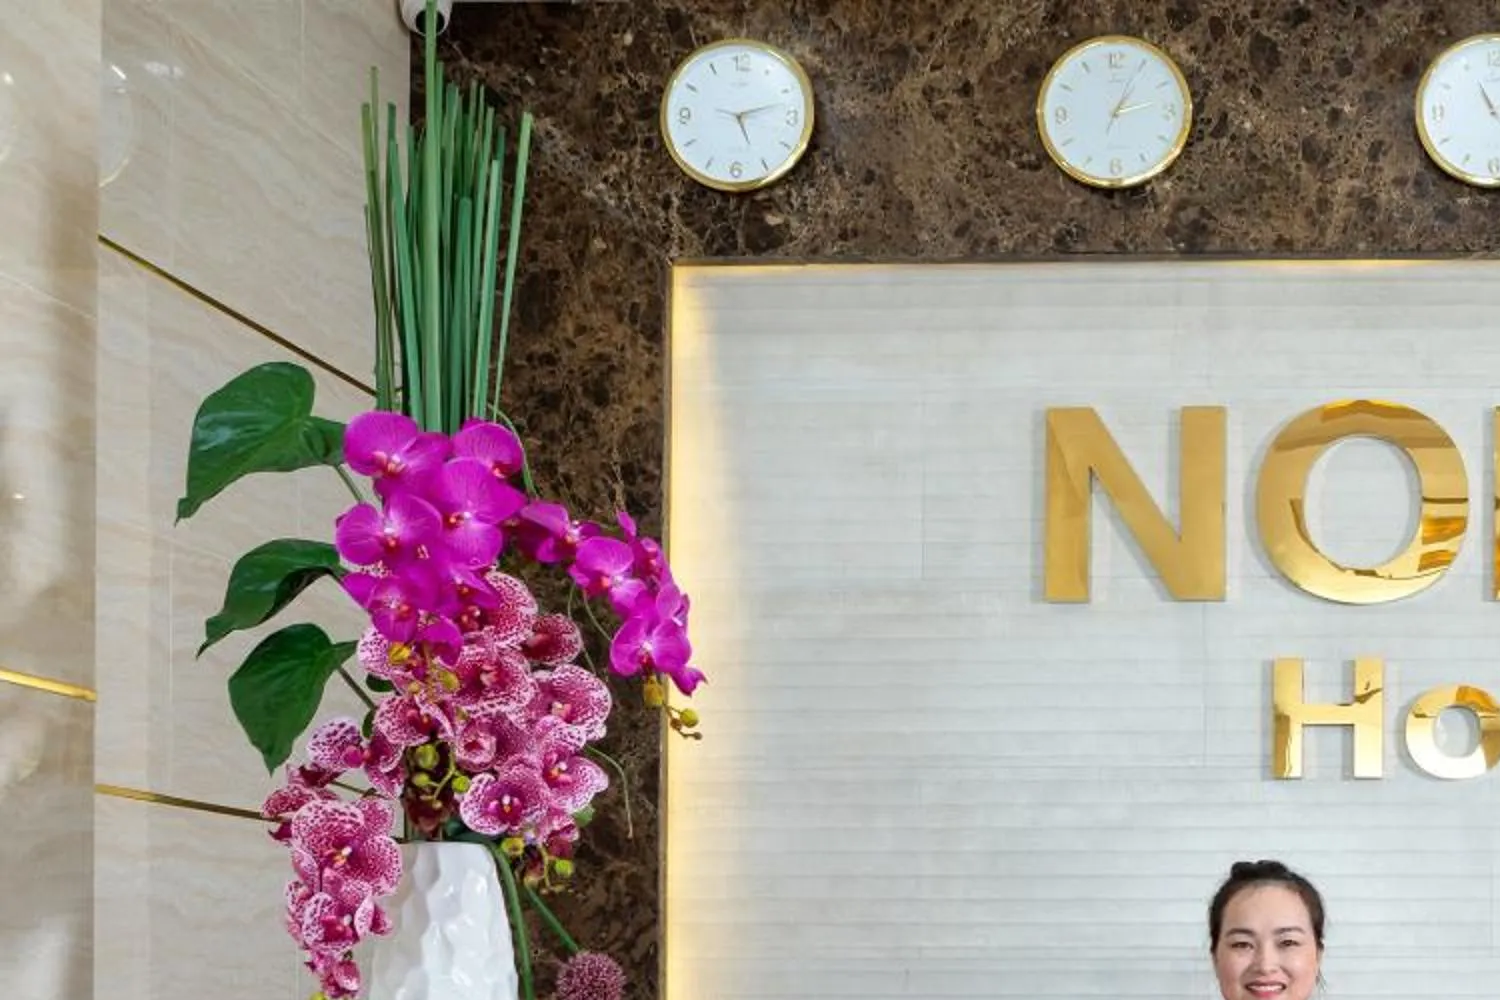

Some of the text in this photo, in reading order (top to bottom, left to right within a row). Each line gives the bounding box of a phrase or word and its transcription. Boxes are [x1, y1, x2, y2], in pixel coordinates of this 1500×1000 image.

[732, 54, 751, 72] 12
[1107, 52, 1125, 69] 12
[679, 107, 691, 125] 9
[786, 109, 799, 126] 3
[1055, 106, 1067, 124] 9
[729, 161, 742, 178] 6
[1110, 158, 1122, 175] 6
